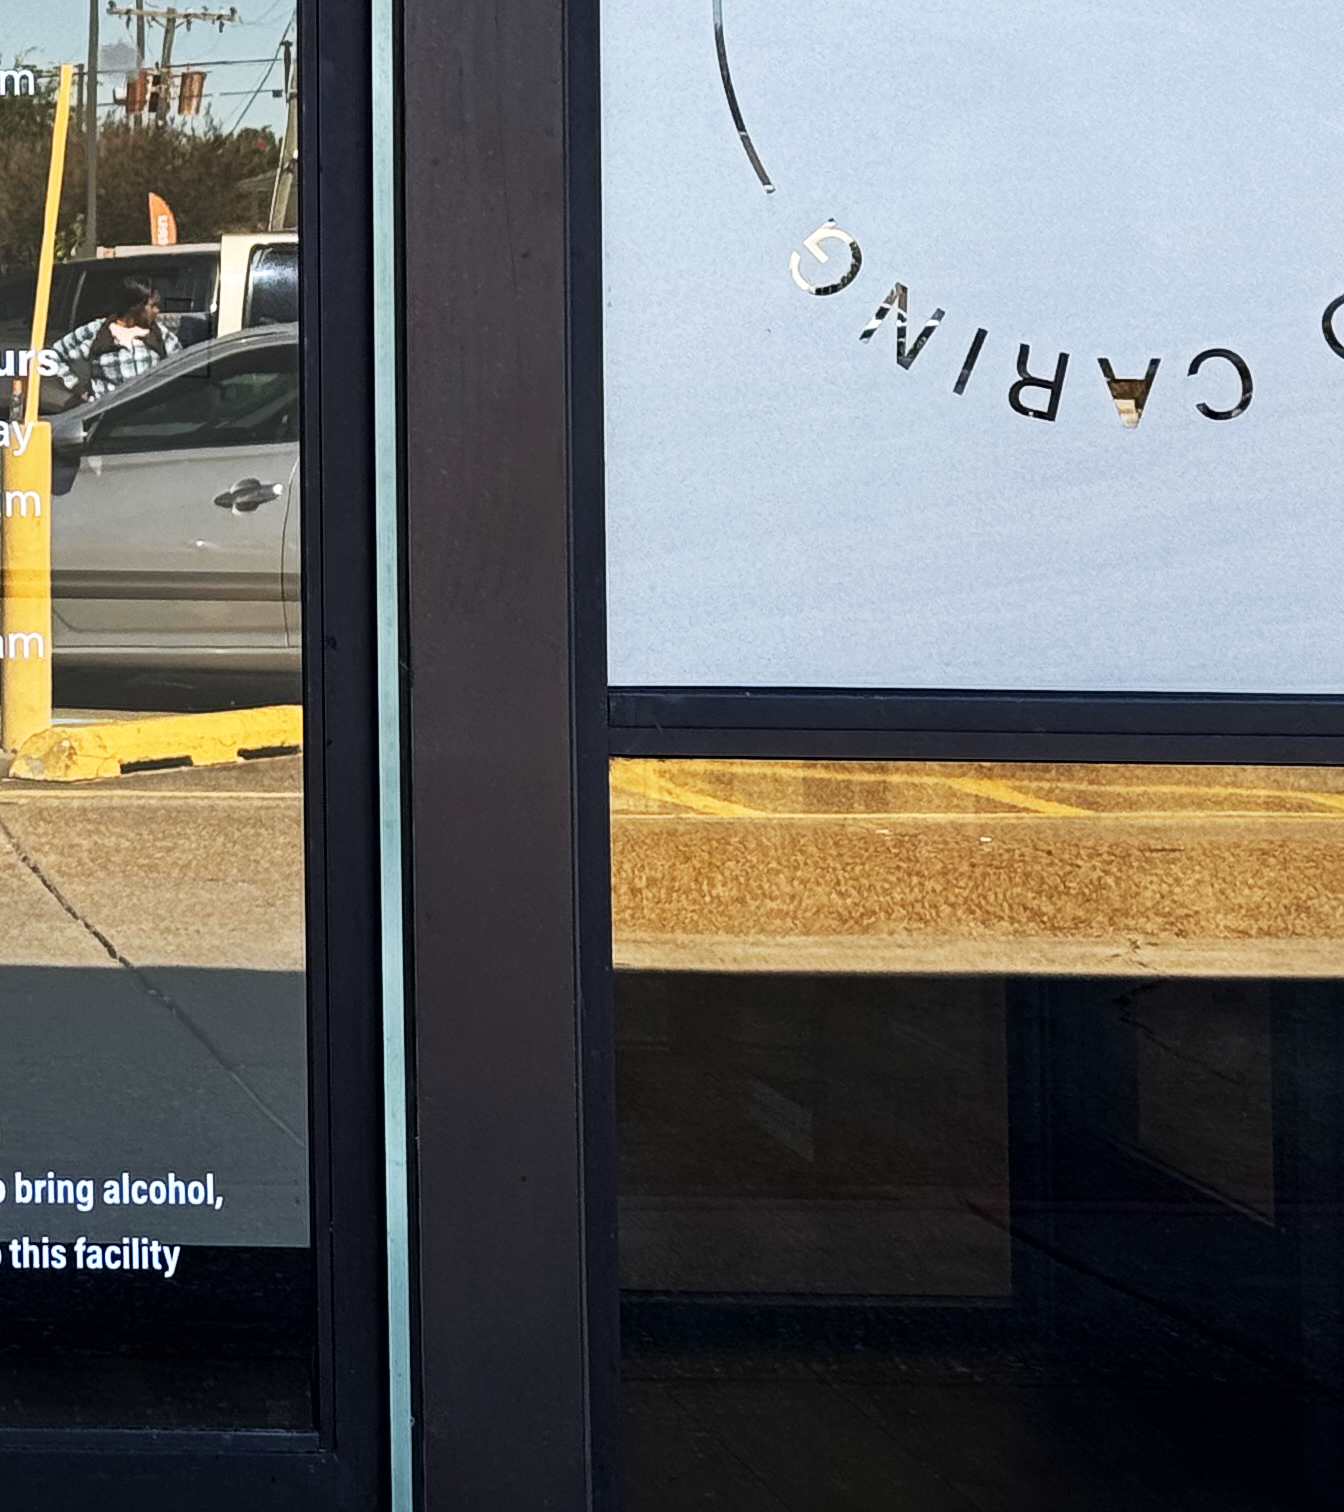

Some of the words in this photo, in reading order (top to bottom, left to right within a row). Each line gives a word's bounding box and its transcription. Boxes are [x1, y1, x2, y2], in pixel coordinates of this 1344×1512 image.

[788, 217, 1255, 429] CARING
[14, 1171, 95, 1212] bring
[102, 1172, 224, 1210] alcohol,
[9, 1236, 67, 1270] this
[74, 1236, 181, 1278] facility
